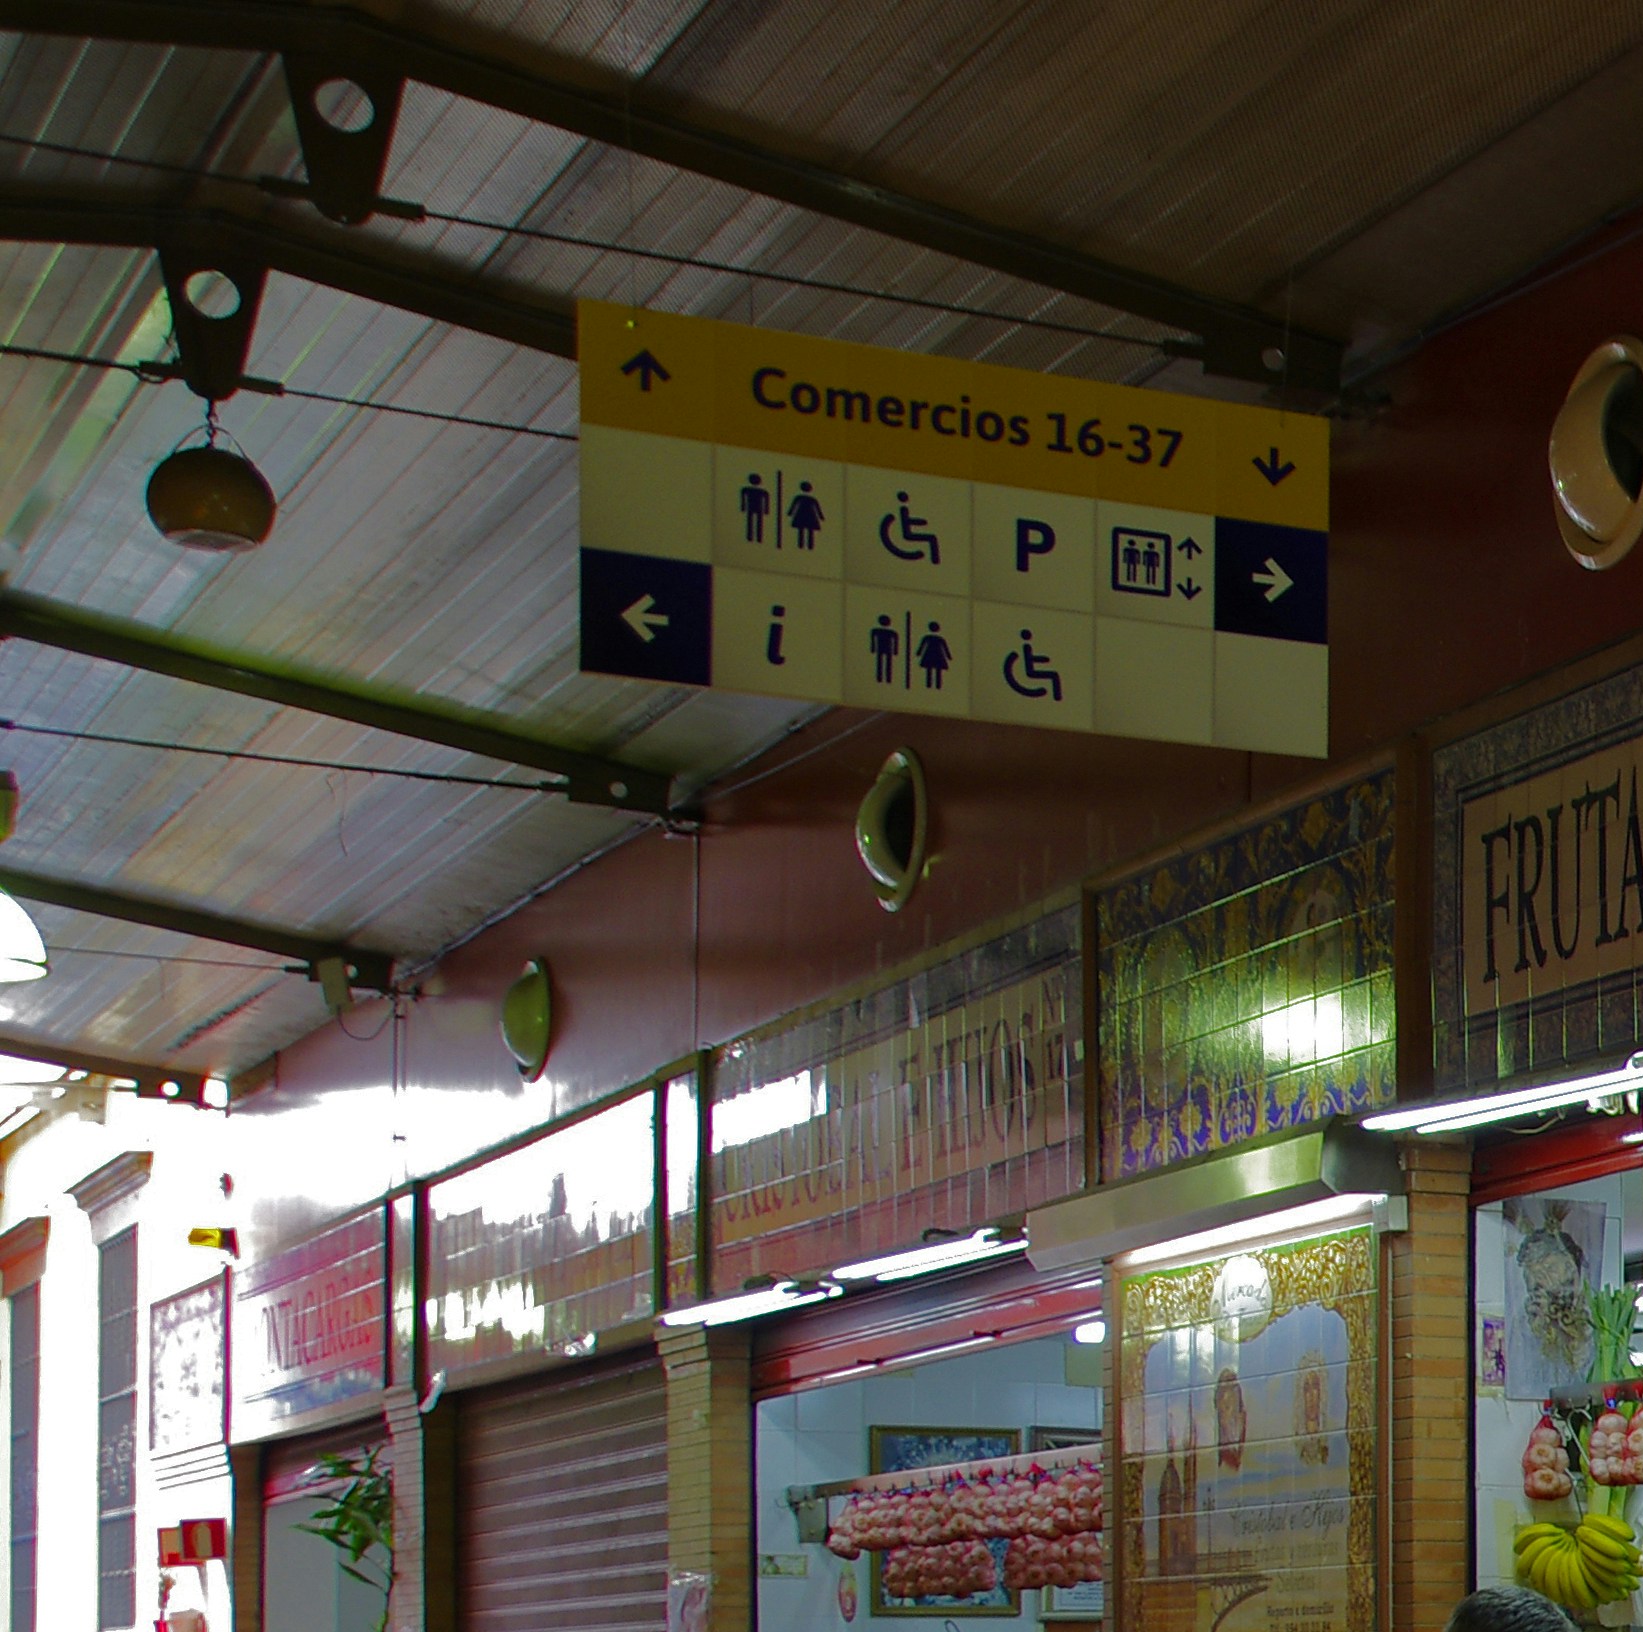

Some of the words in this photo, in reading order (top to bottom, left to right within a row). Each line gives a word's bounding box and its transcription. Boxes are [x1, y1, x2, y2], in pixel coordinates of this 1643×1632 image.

[751, 366, 1030, 447] Comercios
[1046, 412, 1184, 469] 16-37
[1015, 517, 1056, 573] P
[934, 1010, 1037, 1157] HIJOS
